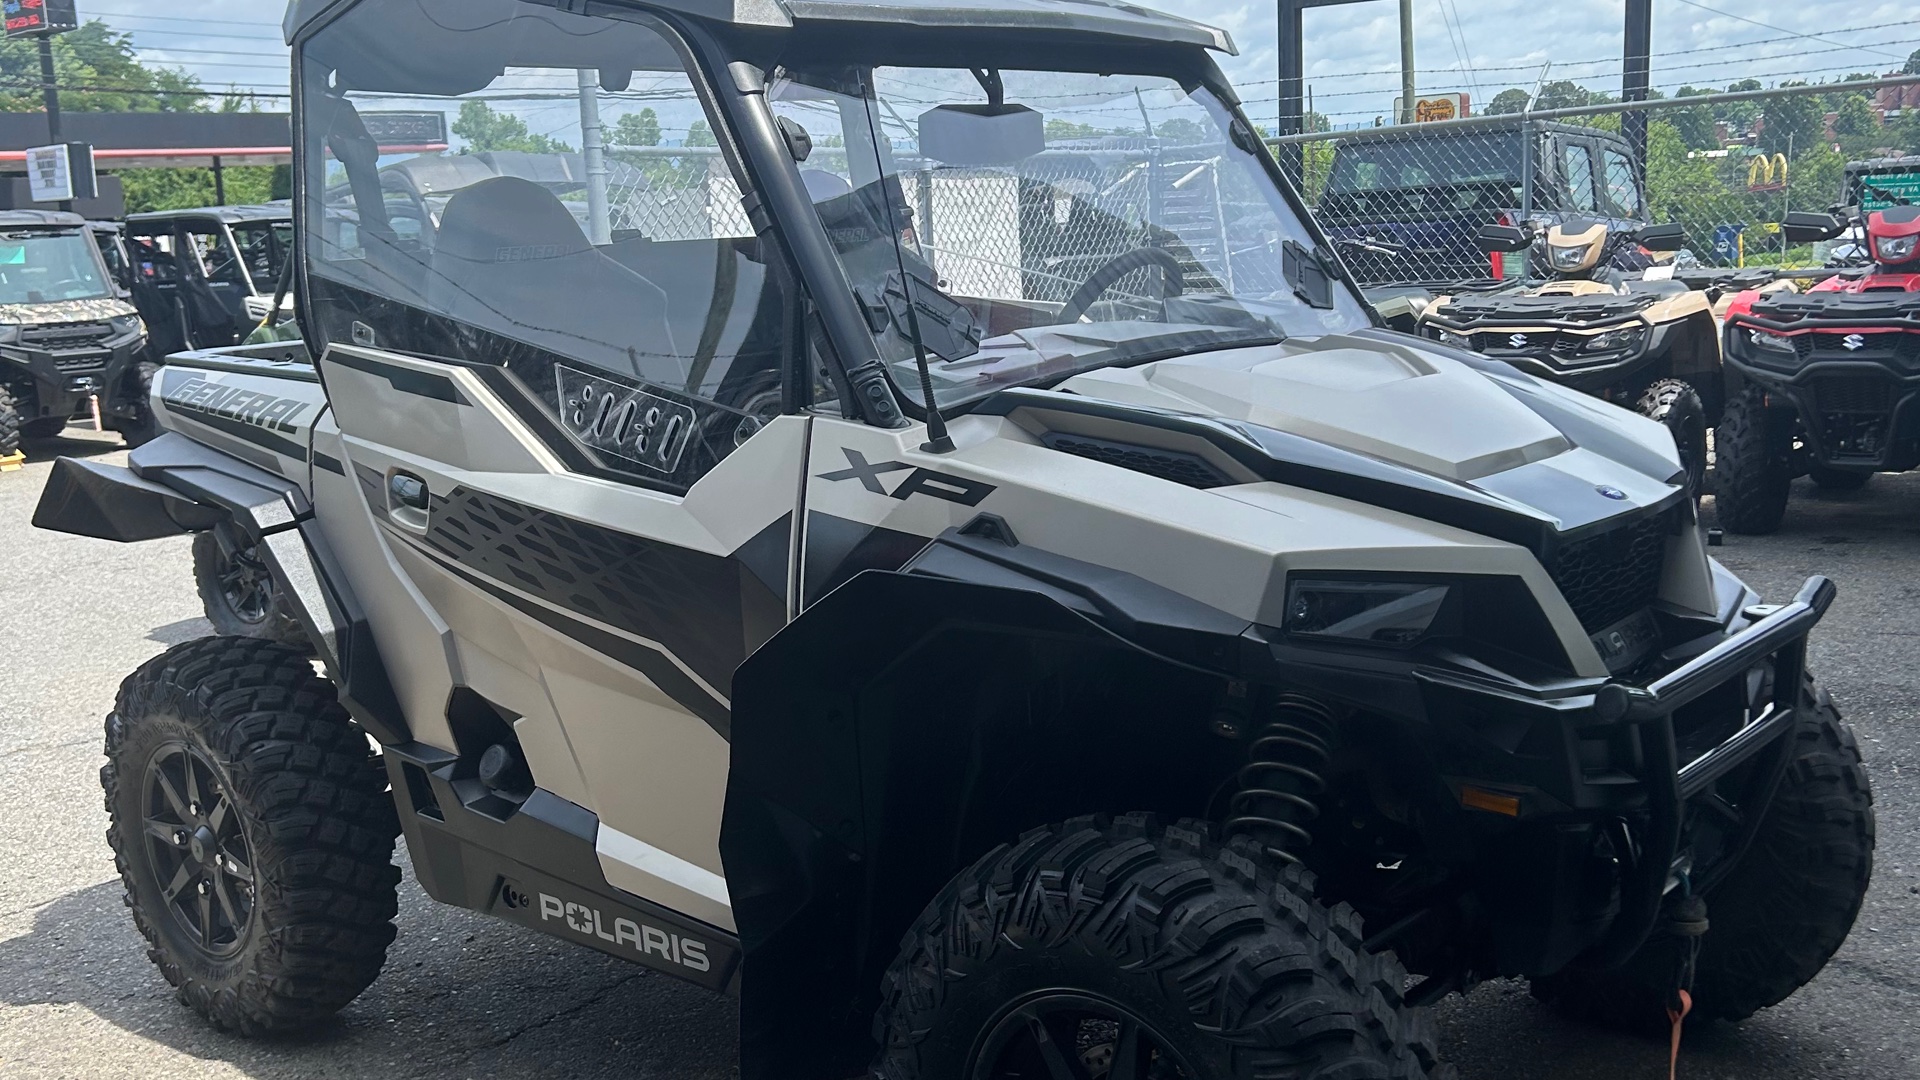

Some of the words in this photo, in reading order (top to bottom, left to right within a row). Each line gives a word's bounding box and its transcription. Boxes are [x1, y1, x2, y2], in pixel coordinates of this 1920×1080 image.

[165, 377, 311, 435] GENERAL
[814, 446, 998, 507] XP
[539, 892, 710, 972] POLARIS
